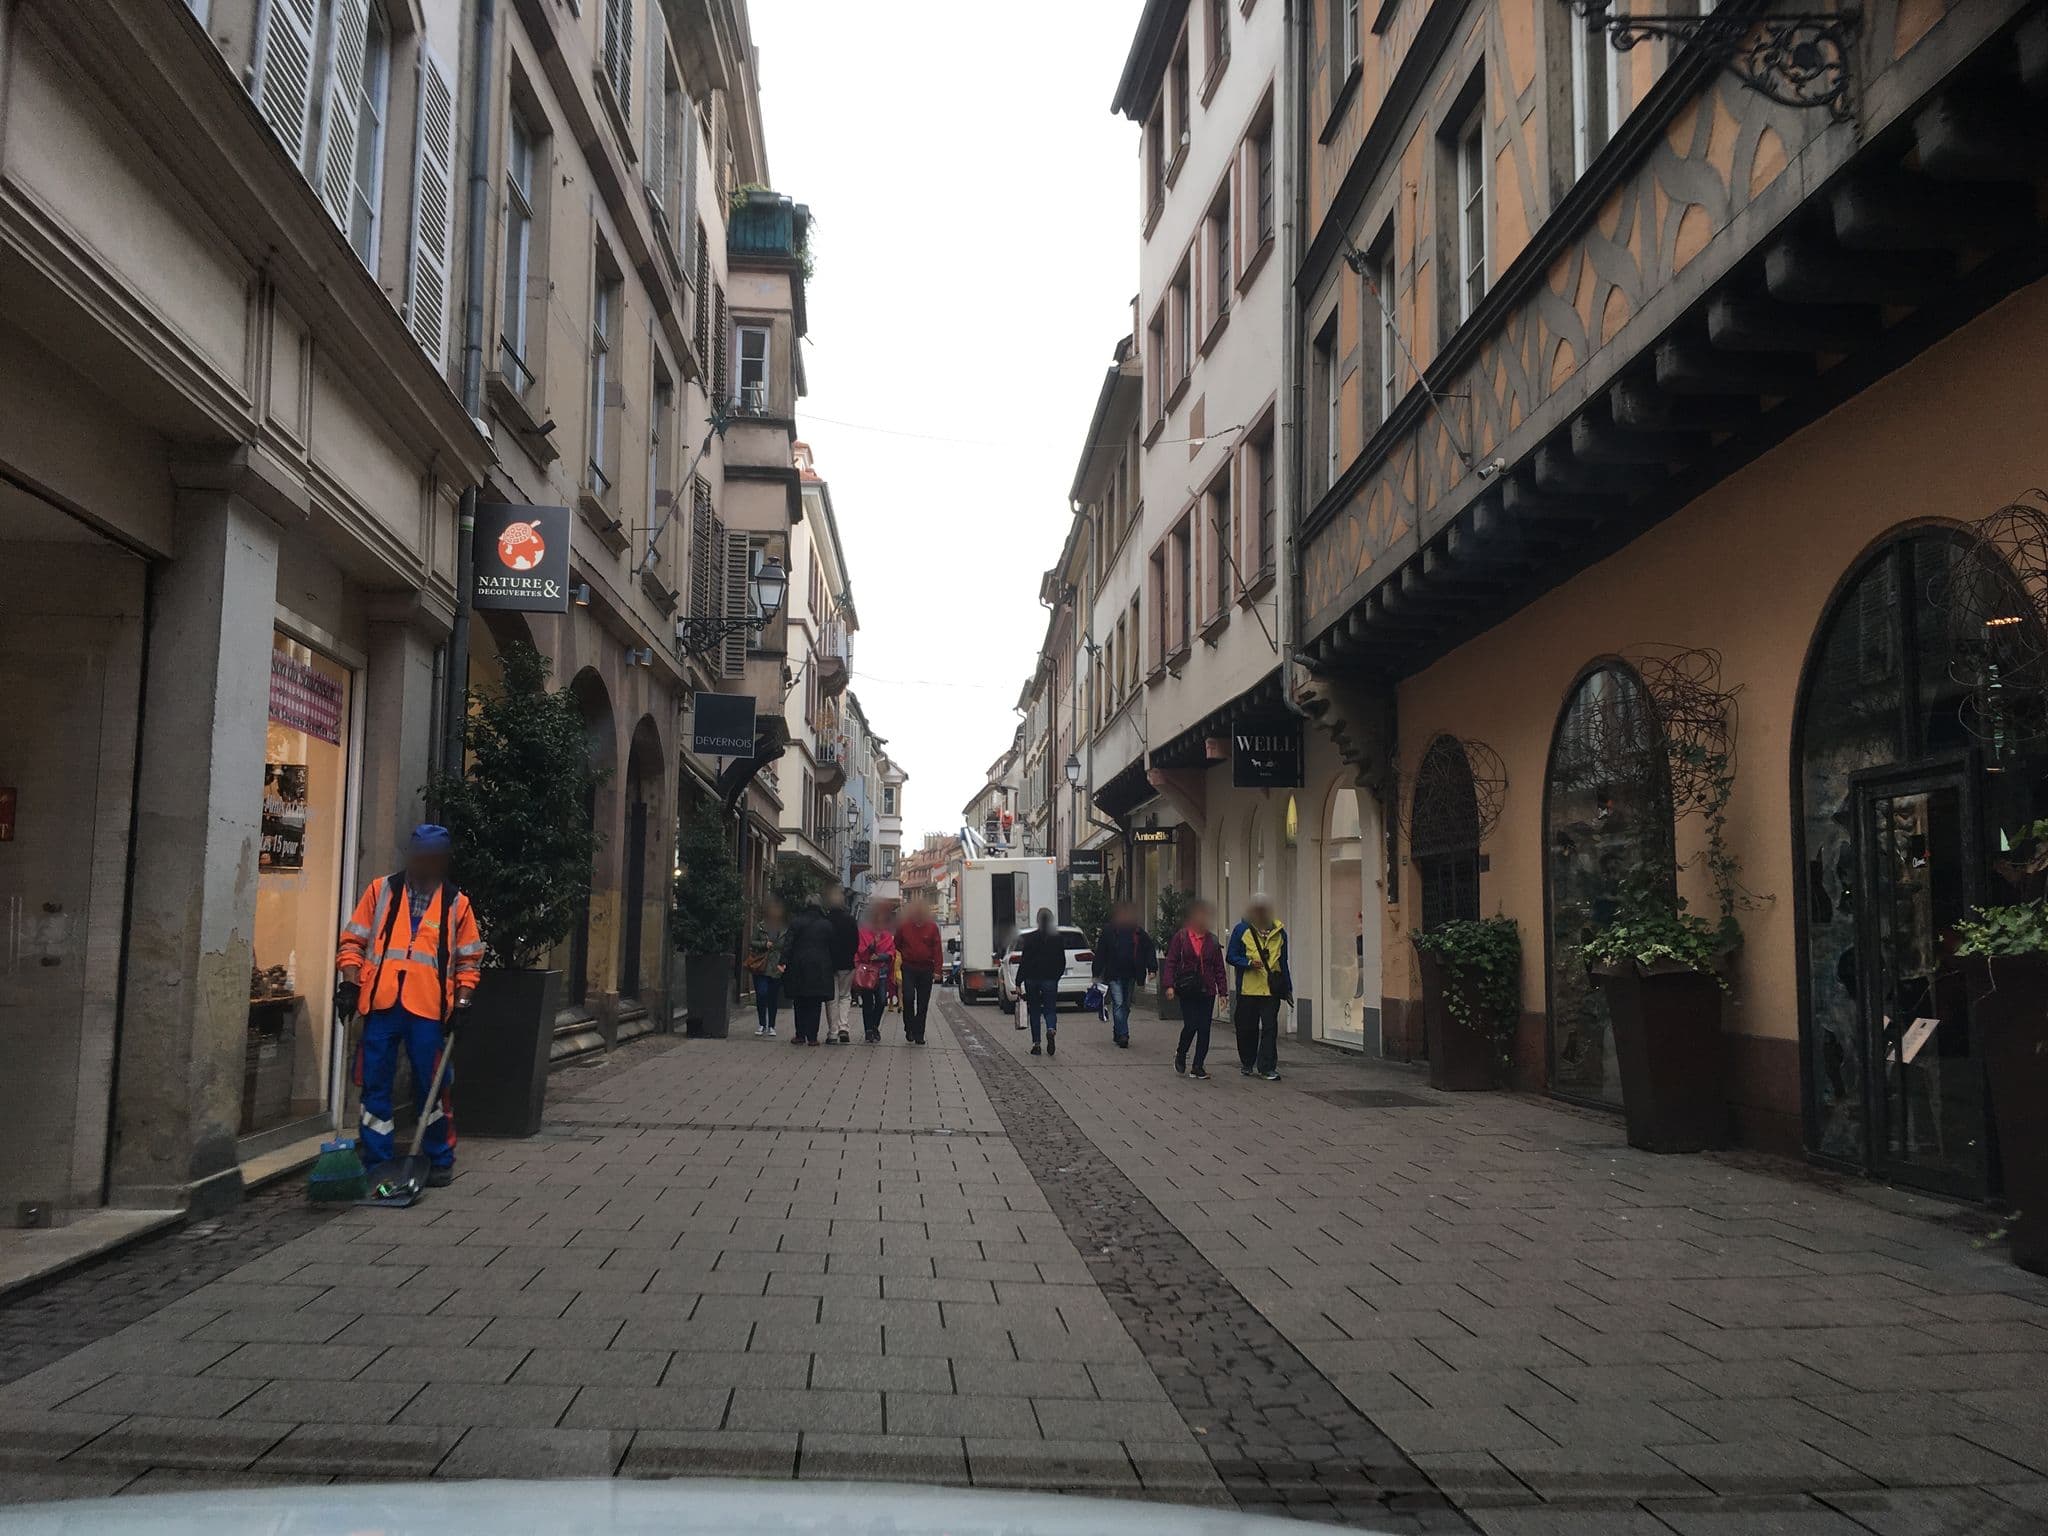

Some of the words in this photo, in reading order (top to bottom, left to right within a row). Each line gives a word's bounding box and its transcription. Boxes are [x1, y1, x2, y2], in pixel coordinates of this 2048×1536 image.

[478, 576, 542, 588] NATURE
[543, 579, 560, 598] &
[478, 588, 542, 597] DECOUVERTES
[695, 735, 752, 748] DEVERNOIS
[1236, 735, 1297, 751] WEILL
